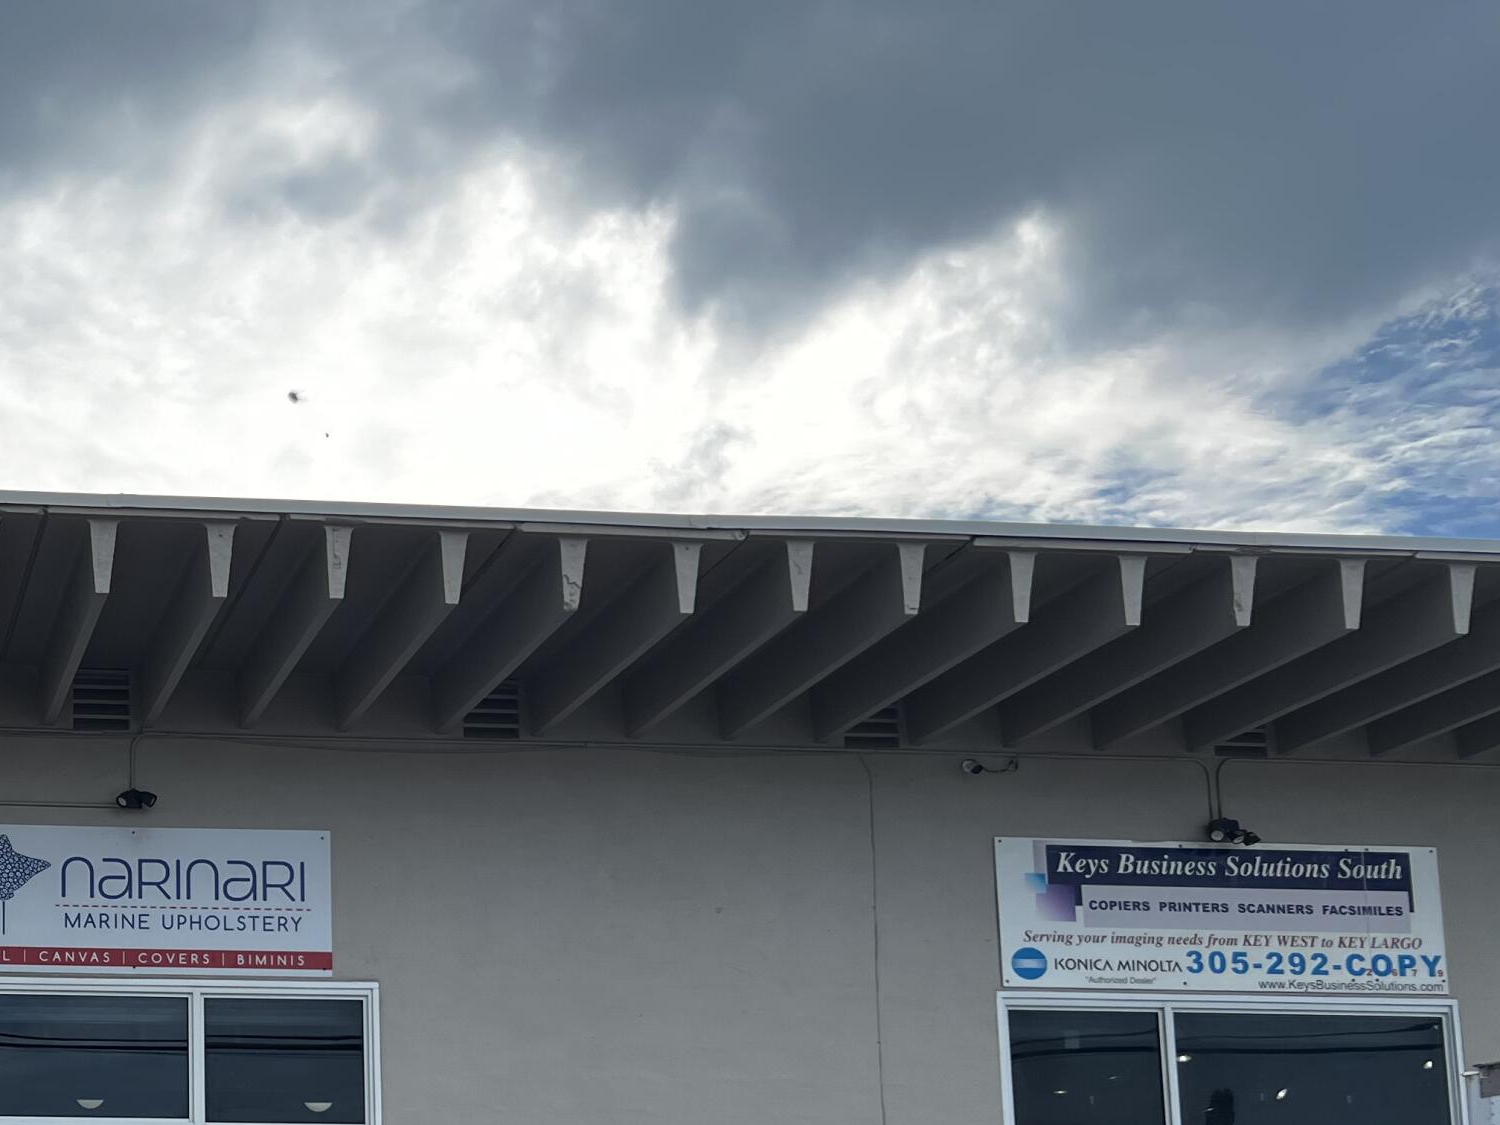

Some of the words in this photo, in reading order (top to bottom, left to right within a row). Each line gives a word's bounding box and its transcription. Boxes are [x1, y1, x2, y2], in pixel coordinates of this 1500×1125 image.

[1056, 852, 1109, 878] Keys
[1117, 853, 1217, 876] Business
[1224, 855, 1331, 878] Solutions
[1337, 858, 1403, 880] South
[1088, 900, 1150, 911] COPIERS
[1159, 902, 1229, 913] PRINTERS
[1237, 903, 1314, 914] SCANNERS
[1322, 905, 1404, 916] FACSIMILES
[63, 912, 151, 930] MARINE
[161, 914, 303, 932] UPHOLSTERY
[1023, 930, 1073, 946] Serving
[1076, 933, 1107, 946] your
[1111, 932, 1164, 947] imaging
[1167, 933, 1203, 946] needs
[1205, 934, 1238, 948] from
[1242, 934, 1273, 947] KEY
[1277, 935, 1319, 948] WEST
[1321, 937, 1333, 948] to
[1338, 936, 1368, 949] KEY
[1370, 937, 1422, 950] LARGO
[39, 950, 111, 963] CANVAS
[138, 952, 210, 965] COVERS
[237, 953, 305, 966] BIMINIS
[1054, 958, 1113, 971] KONICA
[1117, 959, 1183, 972] MINOLTA
[1186, 950, 1442, 977] 305-292-COPY
[1258, 979, 1444, 992] www.KeysBusinessSolutions.com
